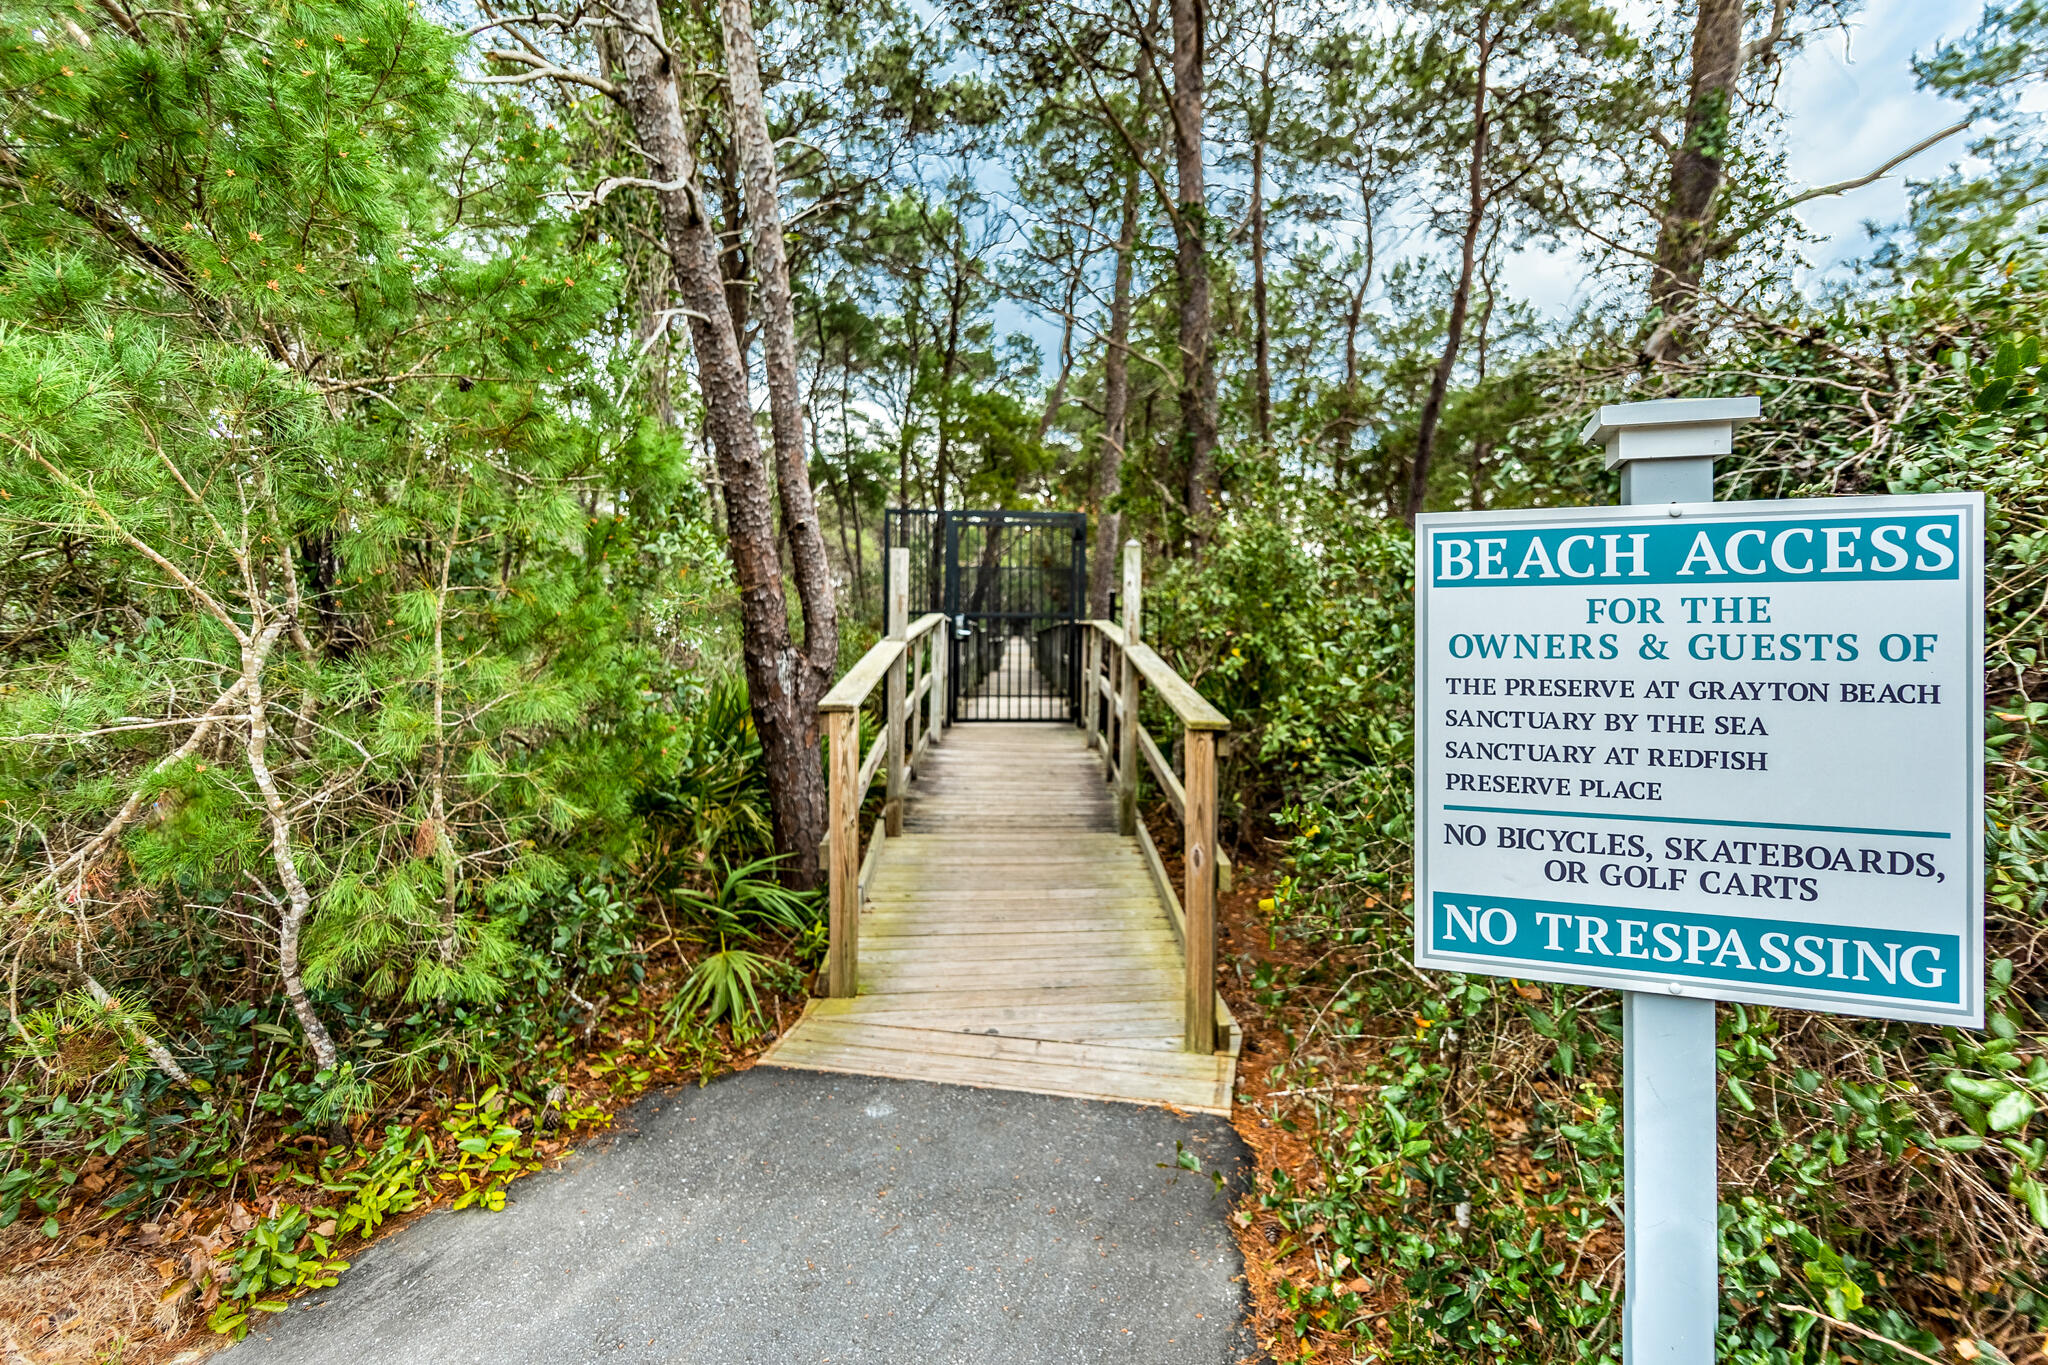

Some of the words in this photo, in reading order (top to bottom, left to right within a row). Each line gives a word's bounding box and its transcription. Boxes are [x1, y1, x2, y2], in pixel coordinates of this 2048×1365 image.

[1437, 533, 1650, 581] BEACH
[1677, 524, 1955, 575] ACCESS
[1586, 598, 1663, 624] FOR
[1681, 596, 1771, 624] THE
[1449, 634, 1618, 660] OWNERS
[1639, 634, 1670, 660] &
[1688, 634, 1858, 661] GUESTS
[1879, 633, 1938, 663] OF
[1446, 677, 1496, 696] THE
[1504, 679, 1634, 698] PRESERVE
[1643, 681, 1679, 699] AT
[1689, 681, 1828, 702] GRAYTON
[1840, 683, 1941, 704] BEACH
[1445, 709, 1596, 732] SANCTUARY
[1604, 713, 1638, 733] BY
[1647, 714, 1706, 735] THE
[1714, 716, 1768, 736] SEA
[1445, 741, 1596, 764] SANCTUARY
[1604, 746, 1639, 766] AT
[1648, 749, 1768, 771] REDFISH
[1445, 773, 1570, 796] PRESERVE
[1580, 779, 1662, 801] PLACE
[1444, 823, 1486, 847] NO
[1497, 826, 1653, 861] BICYCLES,
[1665, 836, 1945, 883] SKATEBOARDS,
[1544, 859, 1588, 883] OR
[1600, 862, 1687, 892] GOLF
[1700, 870, 1818, 902] CARTS
[1443, 904, 1516, 945] NO
[1536, 912, 1947, 988] TRESPASSING
